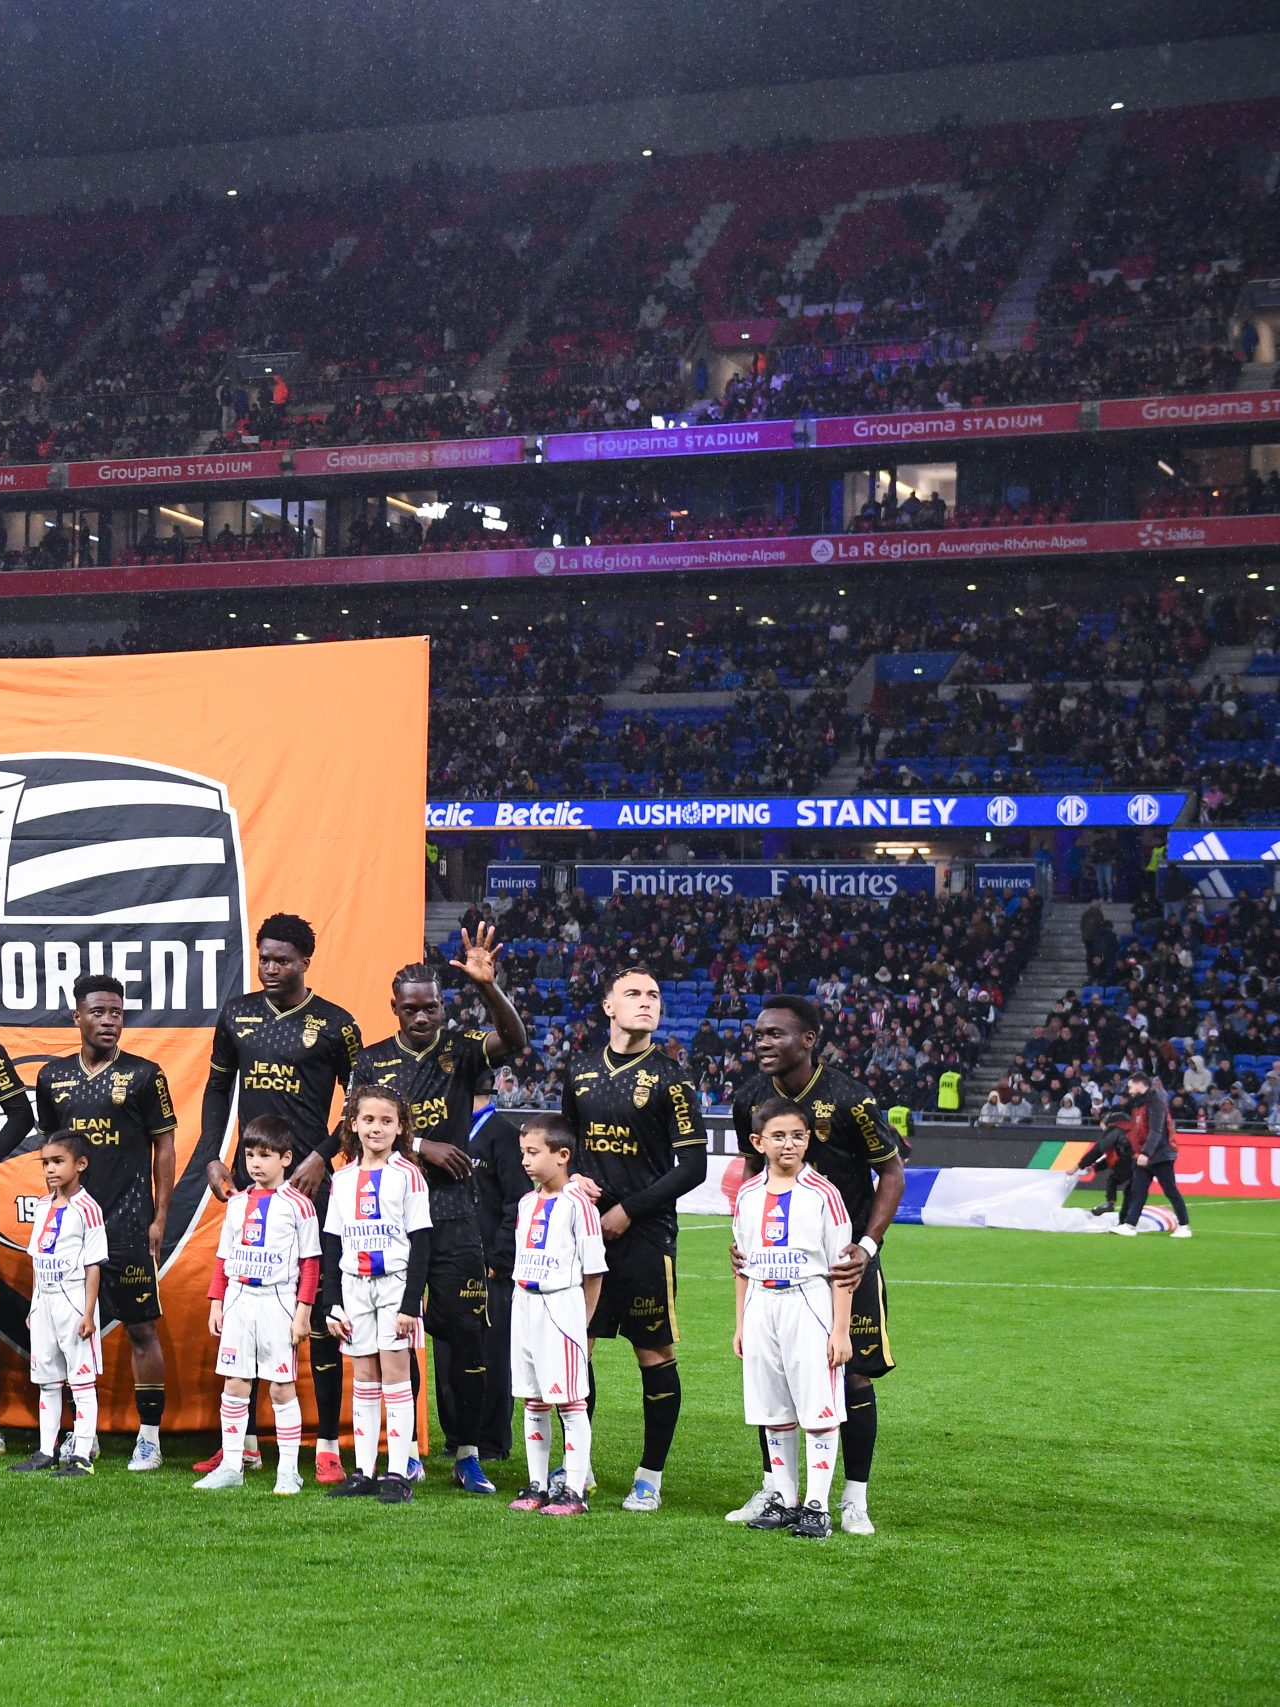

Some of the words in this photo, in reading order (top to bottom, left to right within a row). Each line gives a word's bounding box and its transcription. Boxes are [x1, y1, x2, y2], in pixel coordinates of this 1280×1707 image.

[1141, 401, 1254, 420] Groupama
[853, 420, 956, 439] Groupama
[962, 414, 1044, 430] STADIUM
[583, 436, 679, 455] Groupama
[683, 431, 759, 448] STADIUM
[326, 452, 417, 468] Groupama
[420, 447, 490, 465] STADIUM
[99, 465, 182, 481] Groupama
[187, 461, 252, 475] STADIUM
[937, 535, 1088, 554] Auvergne-Rhône-Alpes
[648, 548, 786, 567] Auvergne-Rhône-Alpes
[425, 802, 474, 826] tclic
[495, 801, 584, 826] Betclic
[617, 802, 770, 825] AUSHOPPING
[796, 798, 957, 826] STANLEY
[988, 797, 1015, 825] MG
[1058, 797, 1086, 824] MG
[1129, 796, 1157, 824] MG
[491, 877, 536, 889] Emirates
[612, 869, 733, 896] Emirates
[979, 876, 1031, 889] Emirates
[250, 1061, 294, 1077] JEAN
[244, 1077, 300, 1094] FLOC'H
[155, 1077, 174, 1119] actual
[411, 1097, 445, 1115] EAN
[669, 1084, 695, 1134] actual
[69, 1117, 111, 1131] JEAN
[587, 1121, 630, 1138] JEAN
[851, 1104, 885, 1152] actual
[585, 1138, 638, 1155] FLOC'H
[343, 1222, 401, 1237] Emirates
[363, 1238, 392, 1250] BETTER
[230, 1248, 283, 1264] Emirates
[518, 1253, 560, 1270] mirates
[750, 1251, 807, 1265] Emirates
[125, 1265, 145, 1276] Cité
[245, 1264, 273, 1277] BETTER
[768, 1267, 800, 1278] BETTER
[633, 1297, 656, 1308] Cité
[850, 1314, 872, 1326] Cité
